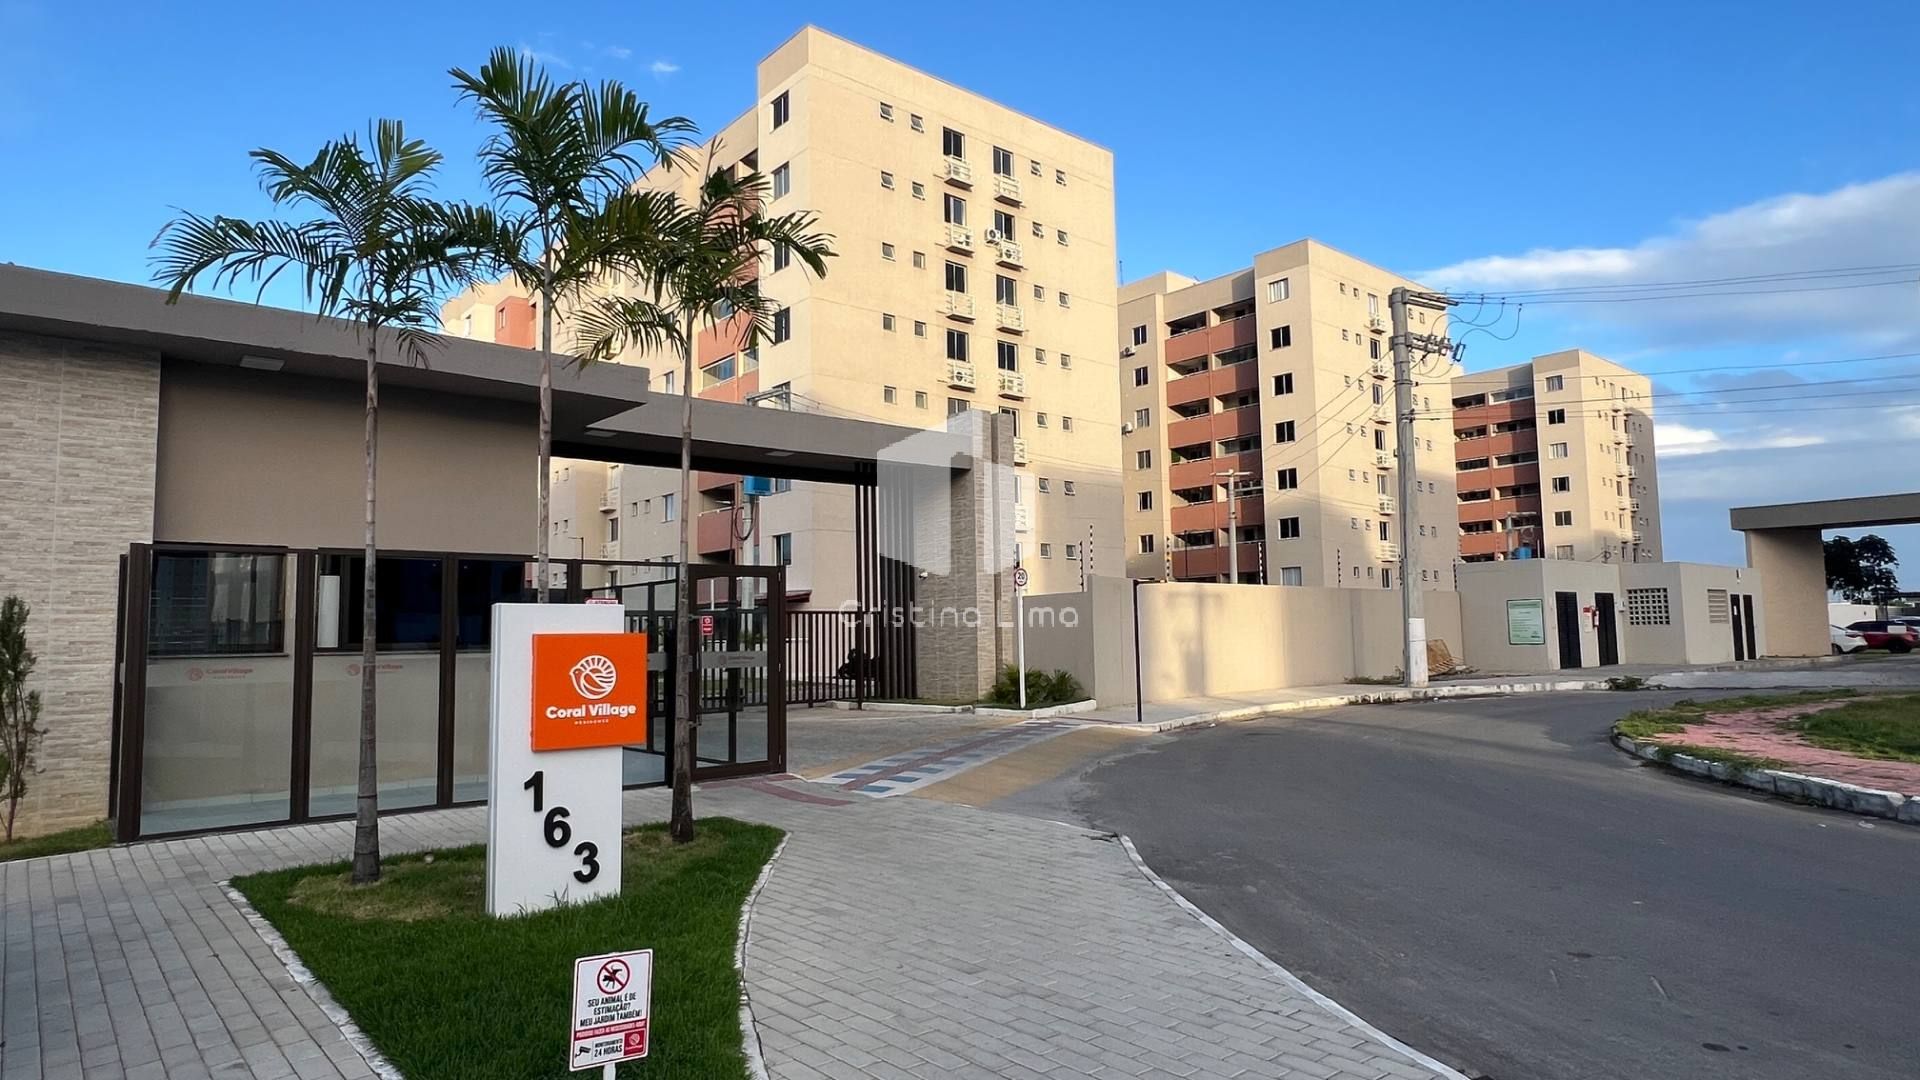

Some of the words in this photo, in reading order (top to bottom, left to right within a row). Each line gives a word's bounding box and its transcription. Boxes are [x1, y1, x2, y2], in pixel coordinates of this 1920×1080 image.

[545, 704, 586, 719] Coral
[588, 703, 637, 718] Village
[587, 998, 600, 1008] SEU
[580, 1017, 593, 1027] MEU
[594, 1048, 602, 1058] 24
